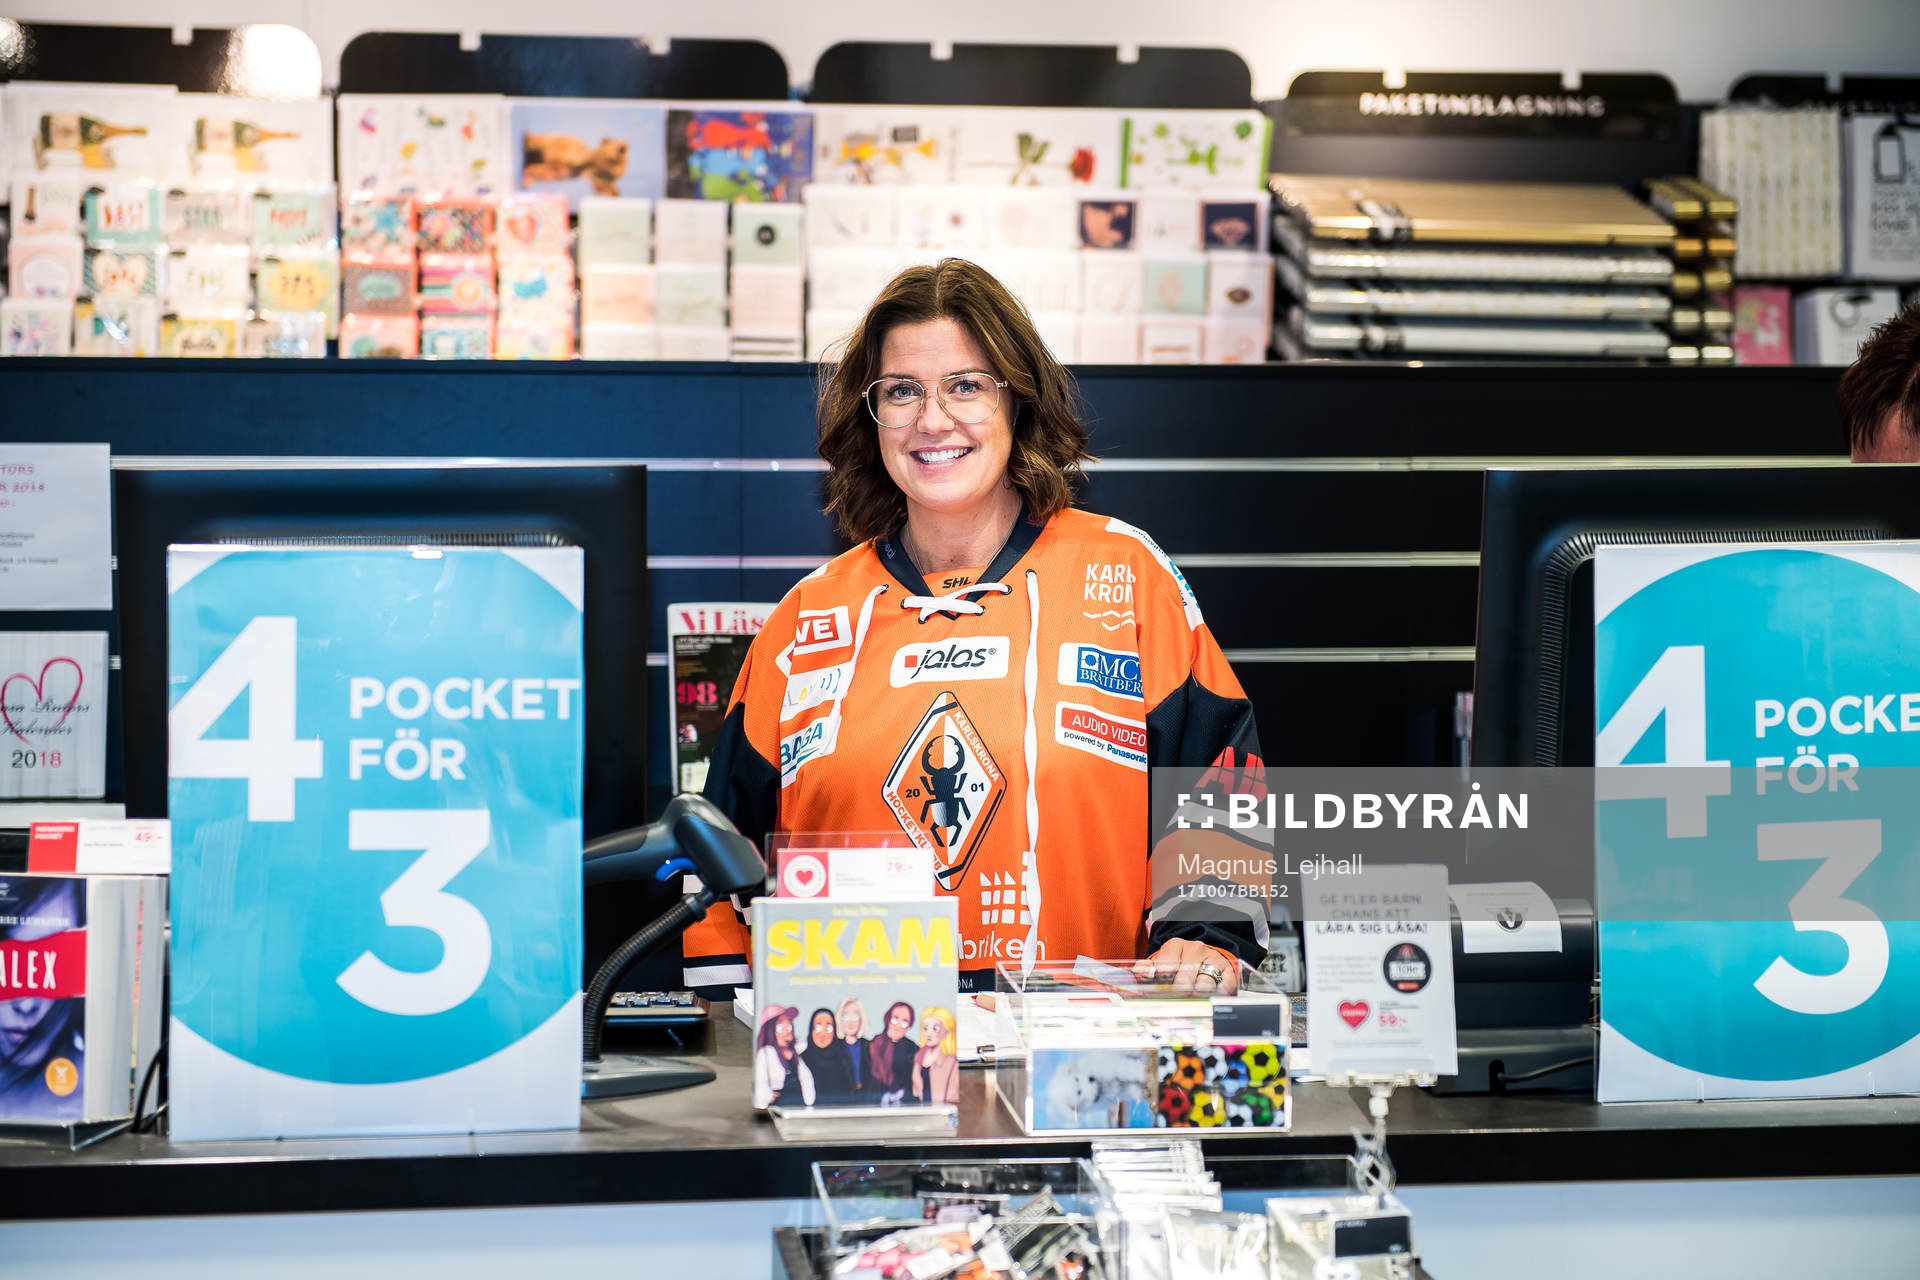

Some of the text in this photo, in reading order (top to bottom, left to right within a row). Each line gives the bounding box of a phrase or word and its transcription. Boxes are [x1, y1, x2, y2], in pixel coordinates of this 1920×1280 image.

[1359, 92, 1605, 118] PAKETINSLAGNING
[942, 577, 972, 589] SHL
[1099, 654, 1141, 681] MC
[349, 677, 579, 721] POCKET
[677, 682, 717, 704] 98
[168, 616, 323, 822] 4
[1072, 714, 1146, 747] AUDIO VIDEO
[1755, 692, 1920, 738] POCKE
[12, 749, 62, 768] 2018
[349, 729, 466, 781] FÖR
[953, 711, 1000, 782] KARLSKRONA
[1063, 731, 1147, 764] powered by Panasonic
[1595, 645, 1731, 838] 4
[971, 783, 984, 792] 01
[1756, 745, 1860, 795] FÖR
[906, 788, 920, 798] 20
[335, 809, 492, 1016] 3
[1360, 922, 1382, 934] SIG
[1753, 818, 1889, 1015] 3
[766, 917, 957, 971] SKAM
